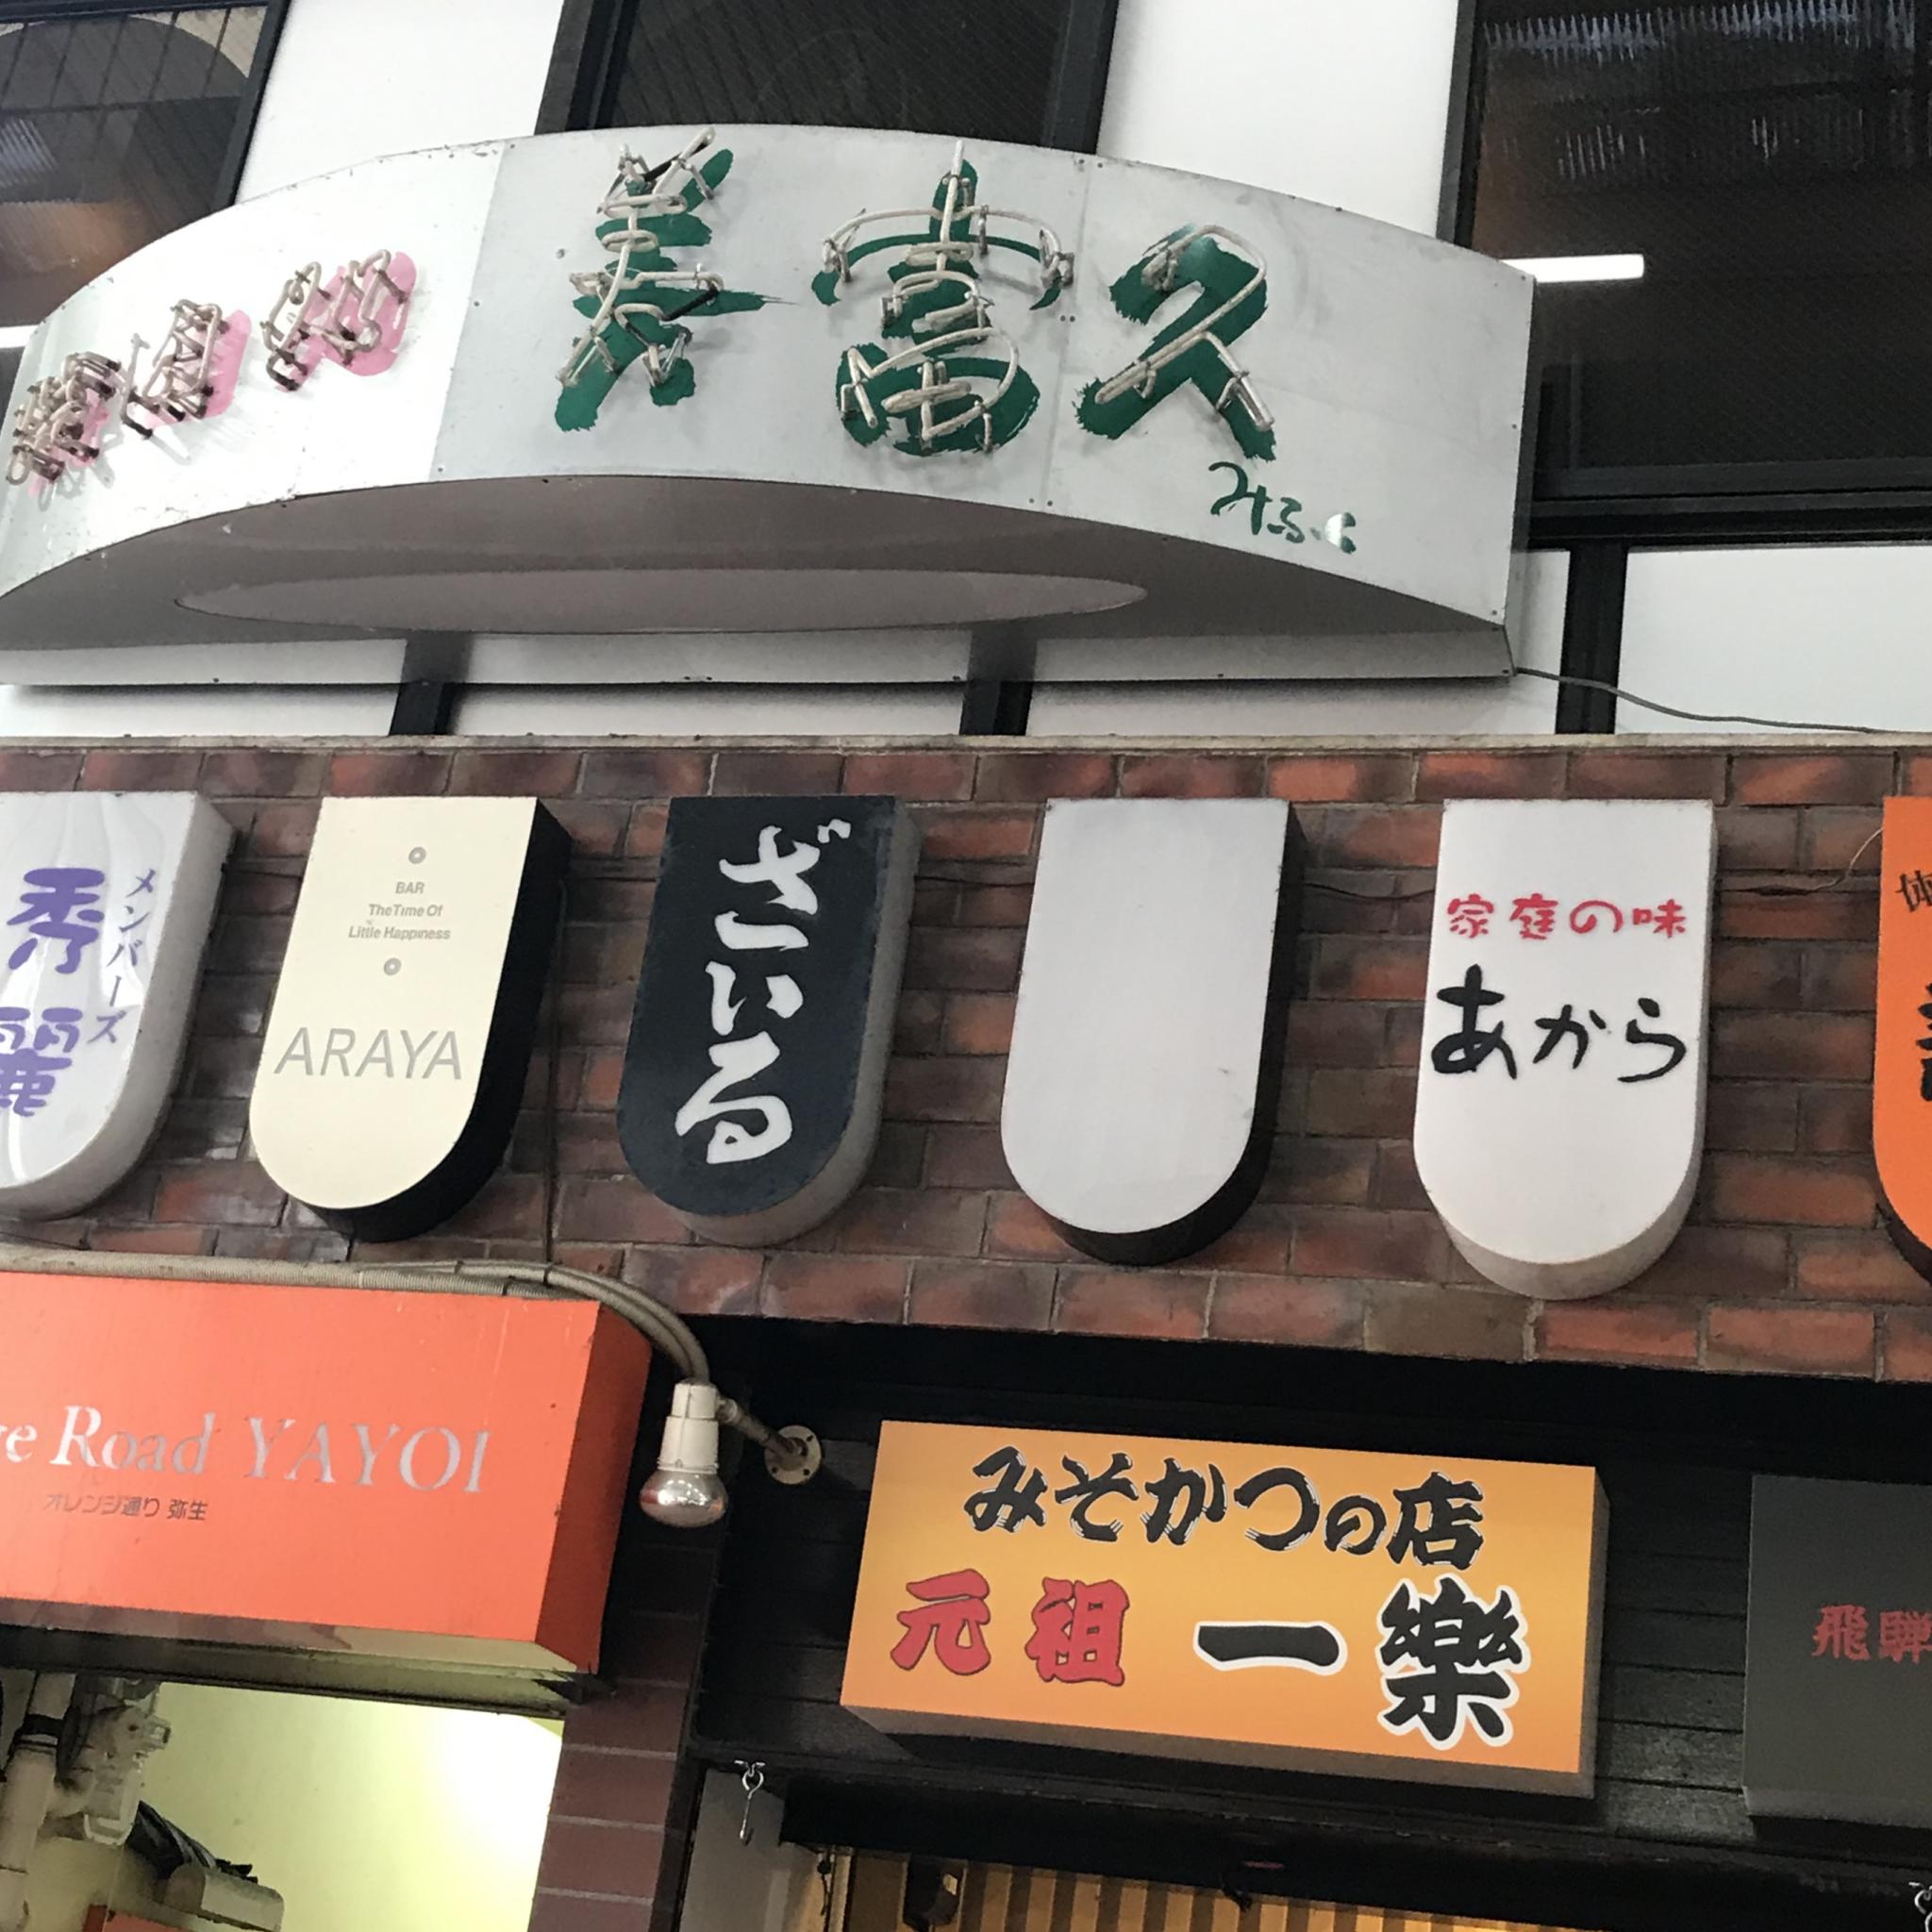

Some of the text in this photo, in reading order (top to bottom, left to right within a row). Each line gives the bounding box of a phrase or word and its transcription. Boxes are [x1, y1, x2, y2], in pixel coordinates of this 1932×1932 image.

[395, 881, 425, 894] BAR
[426, 904, 443, 917] Of
[348, 924, 451, 941] Little Happiness
[1446, 892, 1687, 940] 家庭の味
[86, 868, 156, 1044] メンバーズ
[1431, 963, 1687, 1084] あから
[273, 1026, 463, 1080] ARAYA
[49, 1405, 216, 1475] Road
[242, 1416, 491, 1493] YAYOI
[166, 1498, 208, 1521] 弥生
[964, 1445, 1485, 1570] みそかつの店
[890, 1568, 1131, 1687] 元祖
